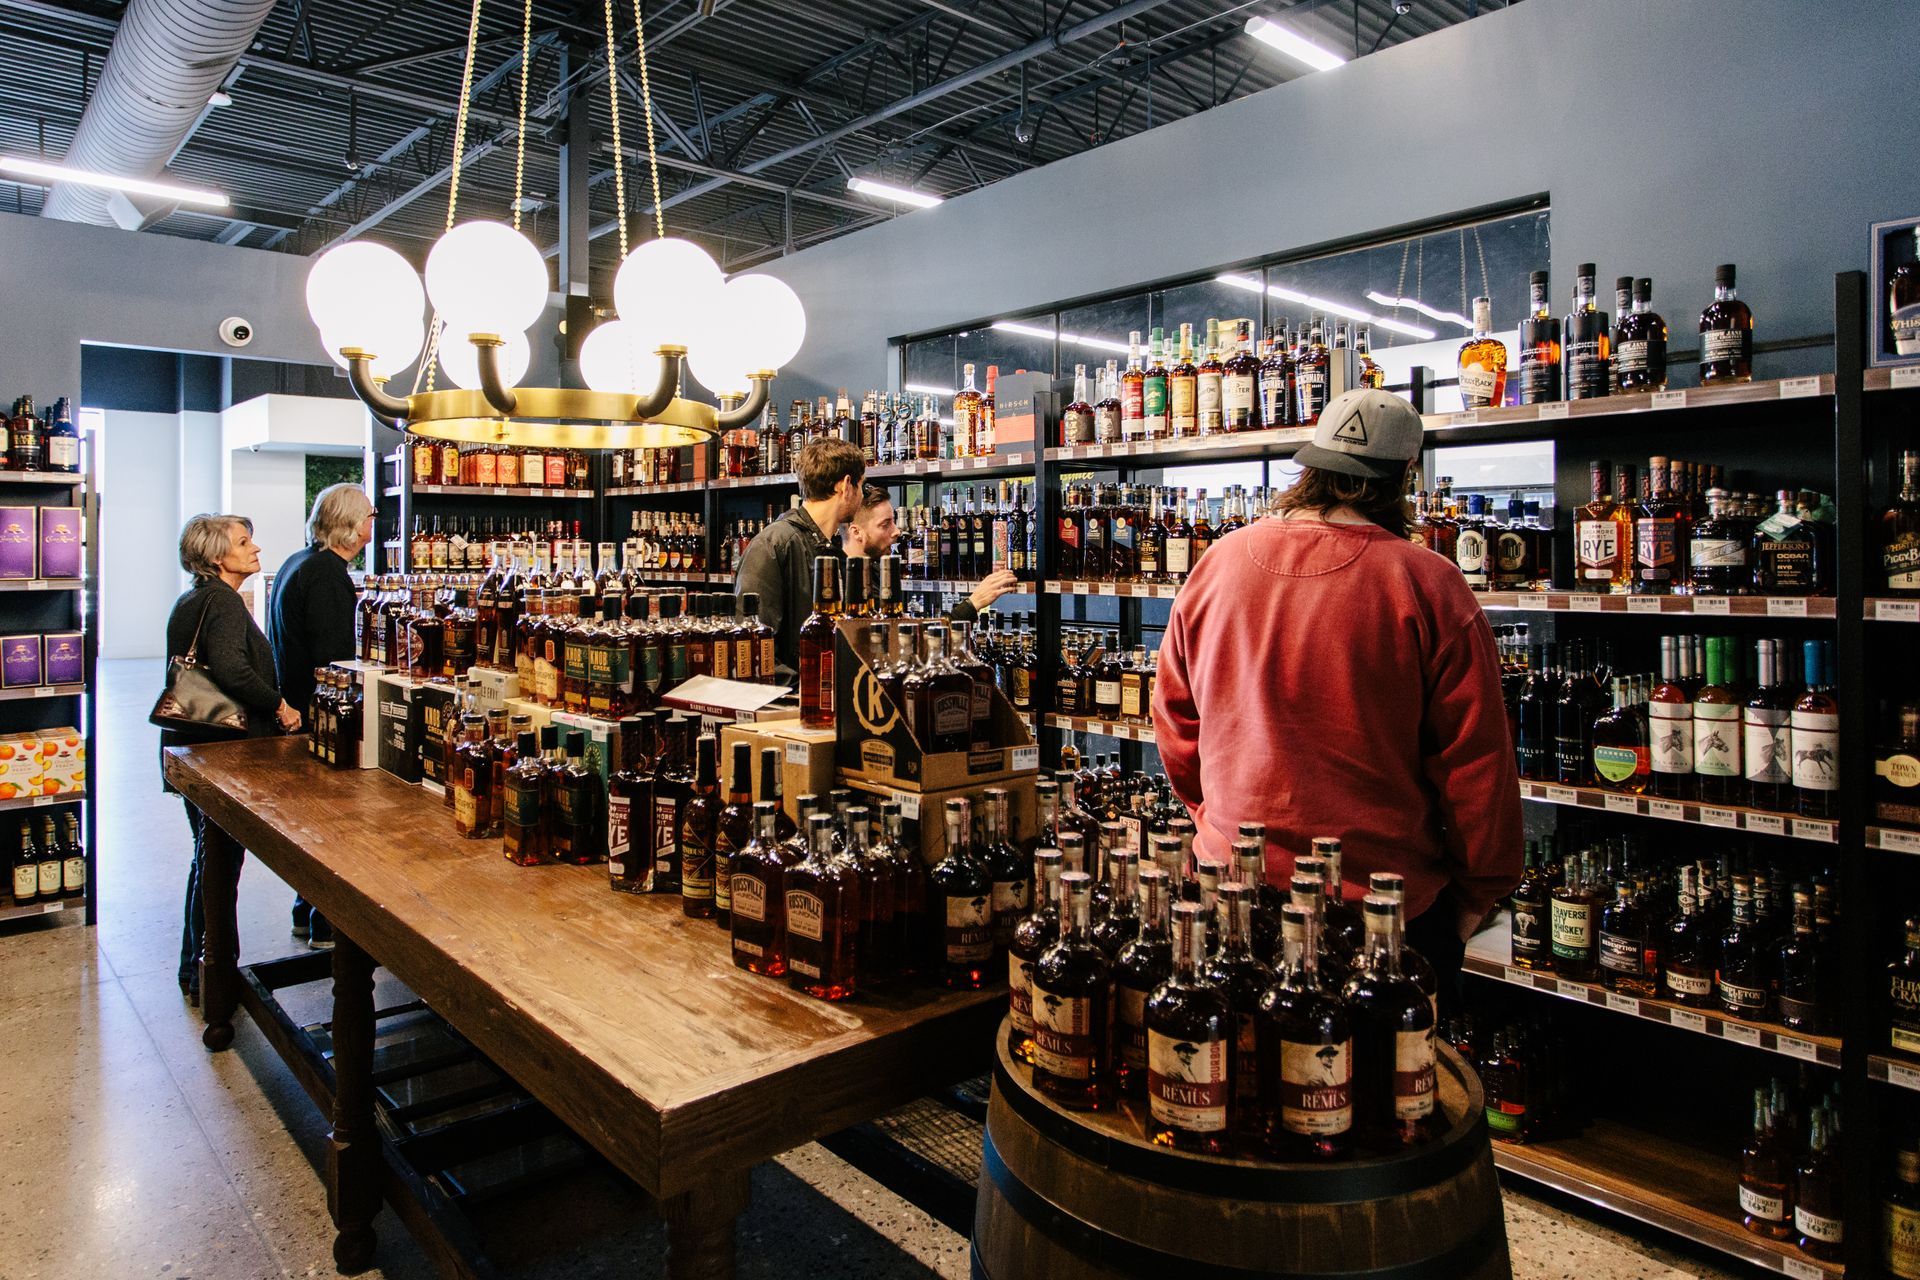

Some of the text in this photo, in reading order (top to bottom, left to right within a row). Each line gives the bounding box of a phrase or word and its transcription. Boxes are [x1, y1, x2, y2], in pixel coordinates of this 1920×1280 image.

[999, 399, 1030, 409] HIRSCH
[1583, 540, 1615, 560] RYE
[1640, 541, 1673, 560] RYE
[566, 646, 582, 662] KNOB
[589, 648, 608, 666] KNOB
[706, 705, 723, 715] SELECT
[1891, 763, 1917, 773] TOWN
[788, 894, 820, 919] ROSSVILLE
[1553, 905, 1587, 920] TRAVERSE
[1735, 906, 1743, 916] 6
[1553, 923, 1585, 937] WHISKEY
[1036, 1030, 1072, 1054] REMUS
[1162, 1083, 1211, 1106] REMUS
[1302, 1092, 1346, 1109] REMUS
